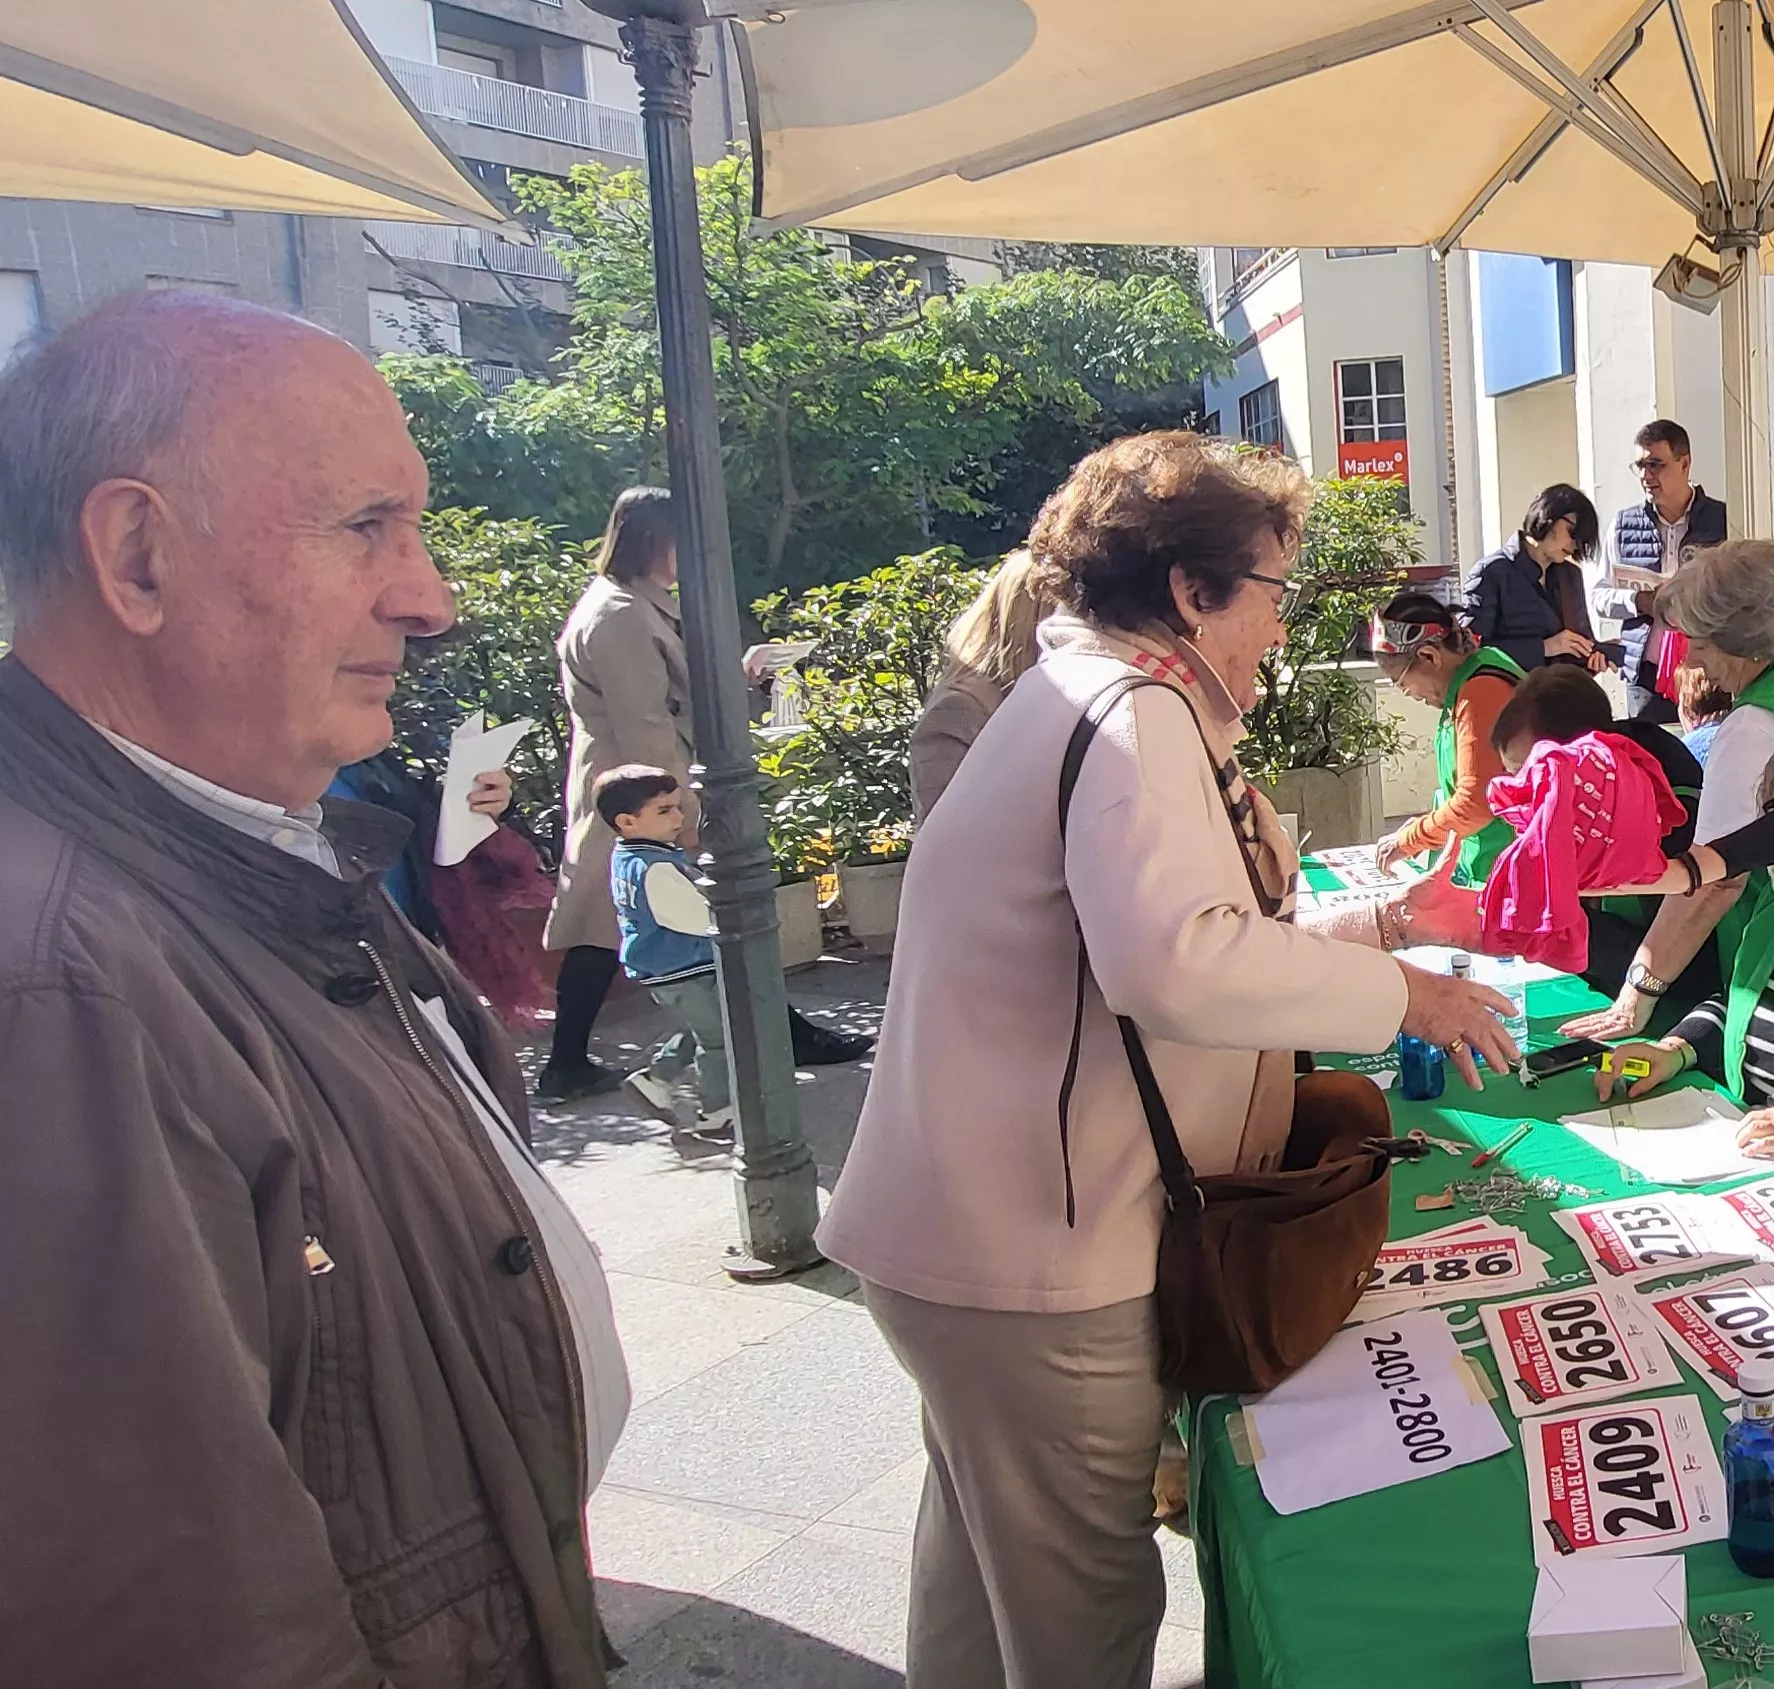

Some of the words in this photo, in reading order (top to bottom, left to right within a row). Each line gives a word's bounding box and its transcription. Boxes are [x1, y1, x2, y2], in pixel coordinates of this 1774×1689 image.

[1344, 458, 1394, 474] Marlex
[1347, 1052, 1399, 1066] espa
[1354, 1061, 1400, 1072] cont
[1612, 1206, 1694, 1264] 2753
[1366, 1252, 1514, 1291] 2486
[1376, 1253, 1419, 1264] NTRA
[1515, 1309, 1538, 1342] CÁNCER
[1671, 1301, 1709, 1334] CÁNCER
[1512, 1339, 1529, 1365] HUESCA
[1529, 1341, 1541, 1354] EL
[1540, 1299, 1630, 1389] 2650
[1713, 1342, 1742, 1371] NTRA
[1532, 1354, 1558, 1394] CONTRA
[1362, 1331, 1453, 1464] 2401-2800
[1560, 1425, 1582, 1473] CÁNCER
[1551, 1465, 1566, 1501] HUESCA
[1567, 1471, 1584, 1487] EL
[1588, 1417, 1677, 1537] 2409
[1569, 1486, 1592, 1541] CONTRA
